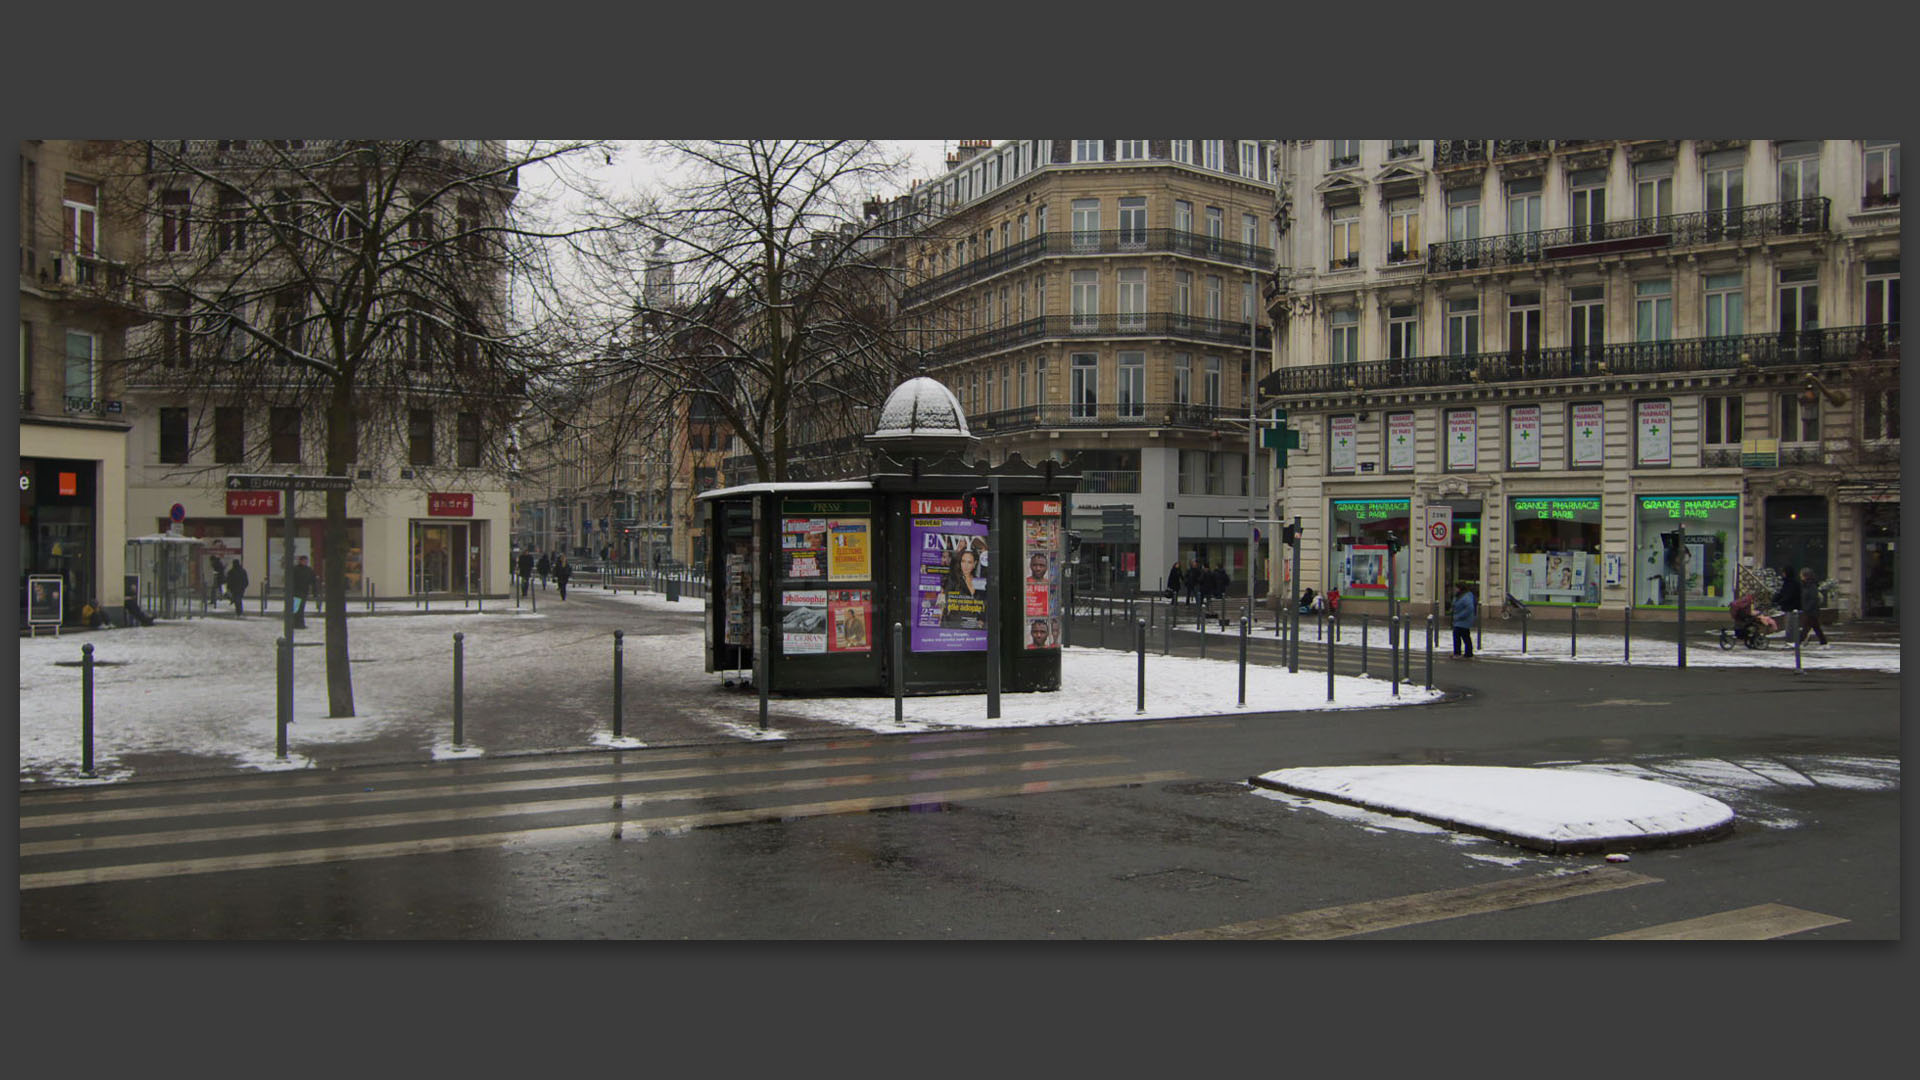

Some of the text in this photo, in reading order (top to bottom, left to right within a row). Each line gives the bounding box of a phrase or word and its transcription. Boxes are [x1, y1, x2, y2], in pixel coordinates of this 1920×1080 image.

[311, 481, 350, 489] Tourisme
[231, 496, 274, 510] andré
[433, 497, 469, 511] andré
[917, 501, 963, 514] TV MAGAZI
[1337, 503, 1409, 512] GRANDE PHARMACIE
[1515, 501, 1600, 510] GRANDE PHARMACIE
[1643, 500, 1737, 509] GRANDE PHARMACIE
[1043, 504, 1058, 512] Nord
[1538, 510, 1575, 519] DE PARIS
[1668, 509, 1708, 518] DE PARIS
[1434, 527, 1444, 536] 30
[923, 533, 974, 551] ENVY
